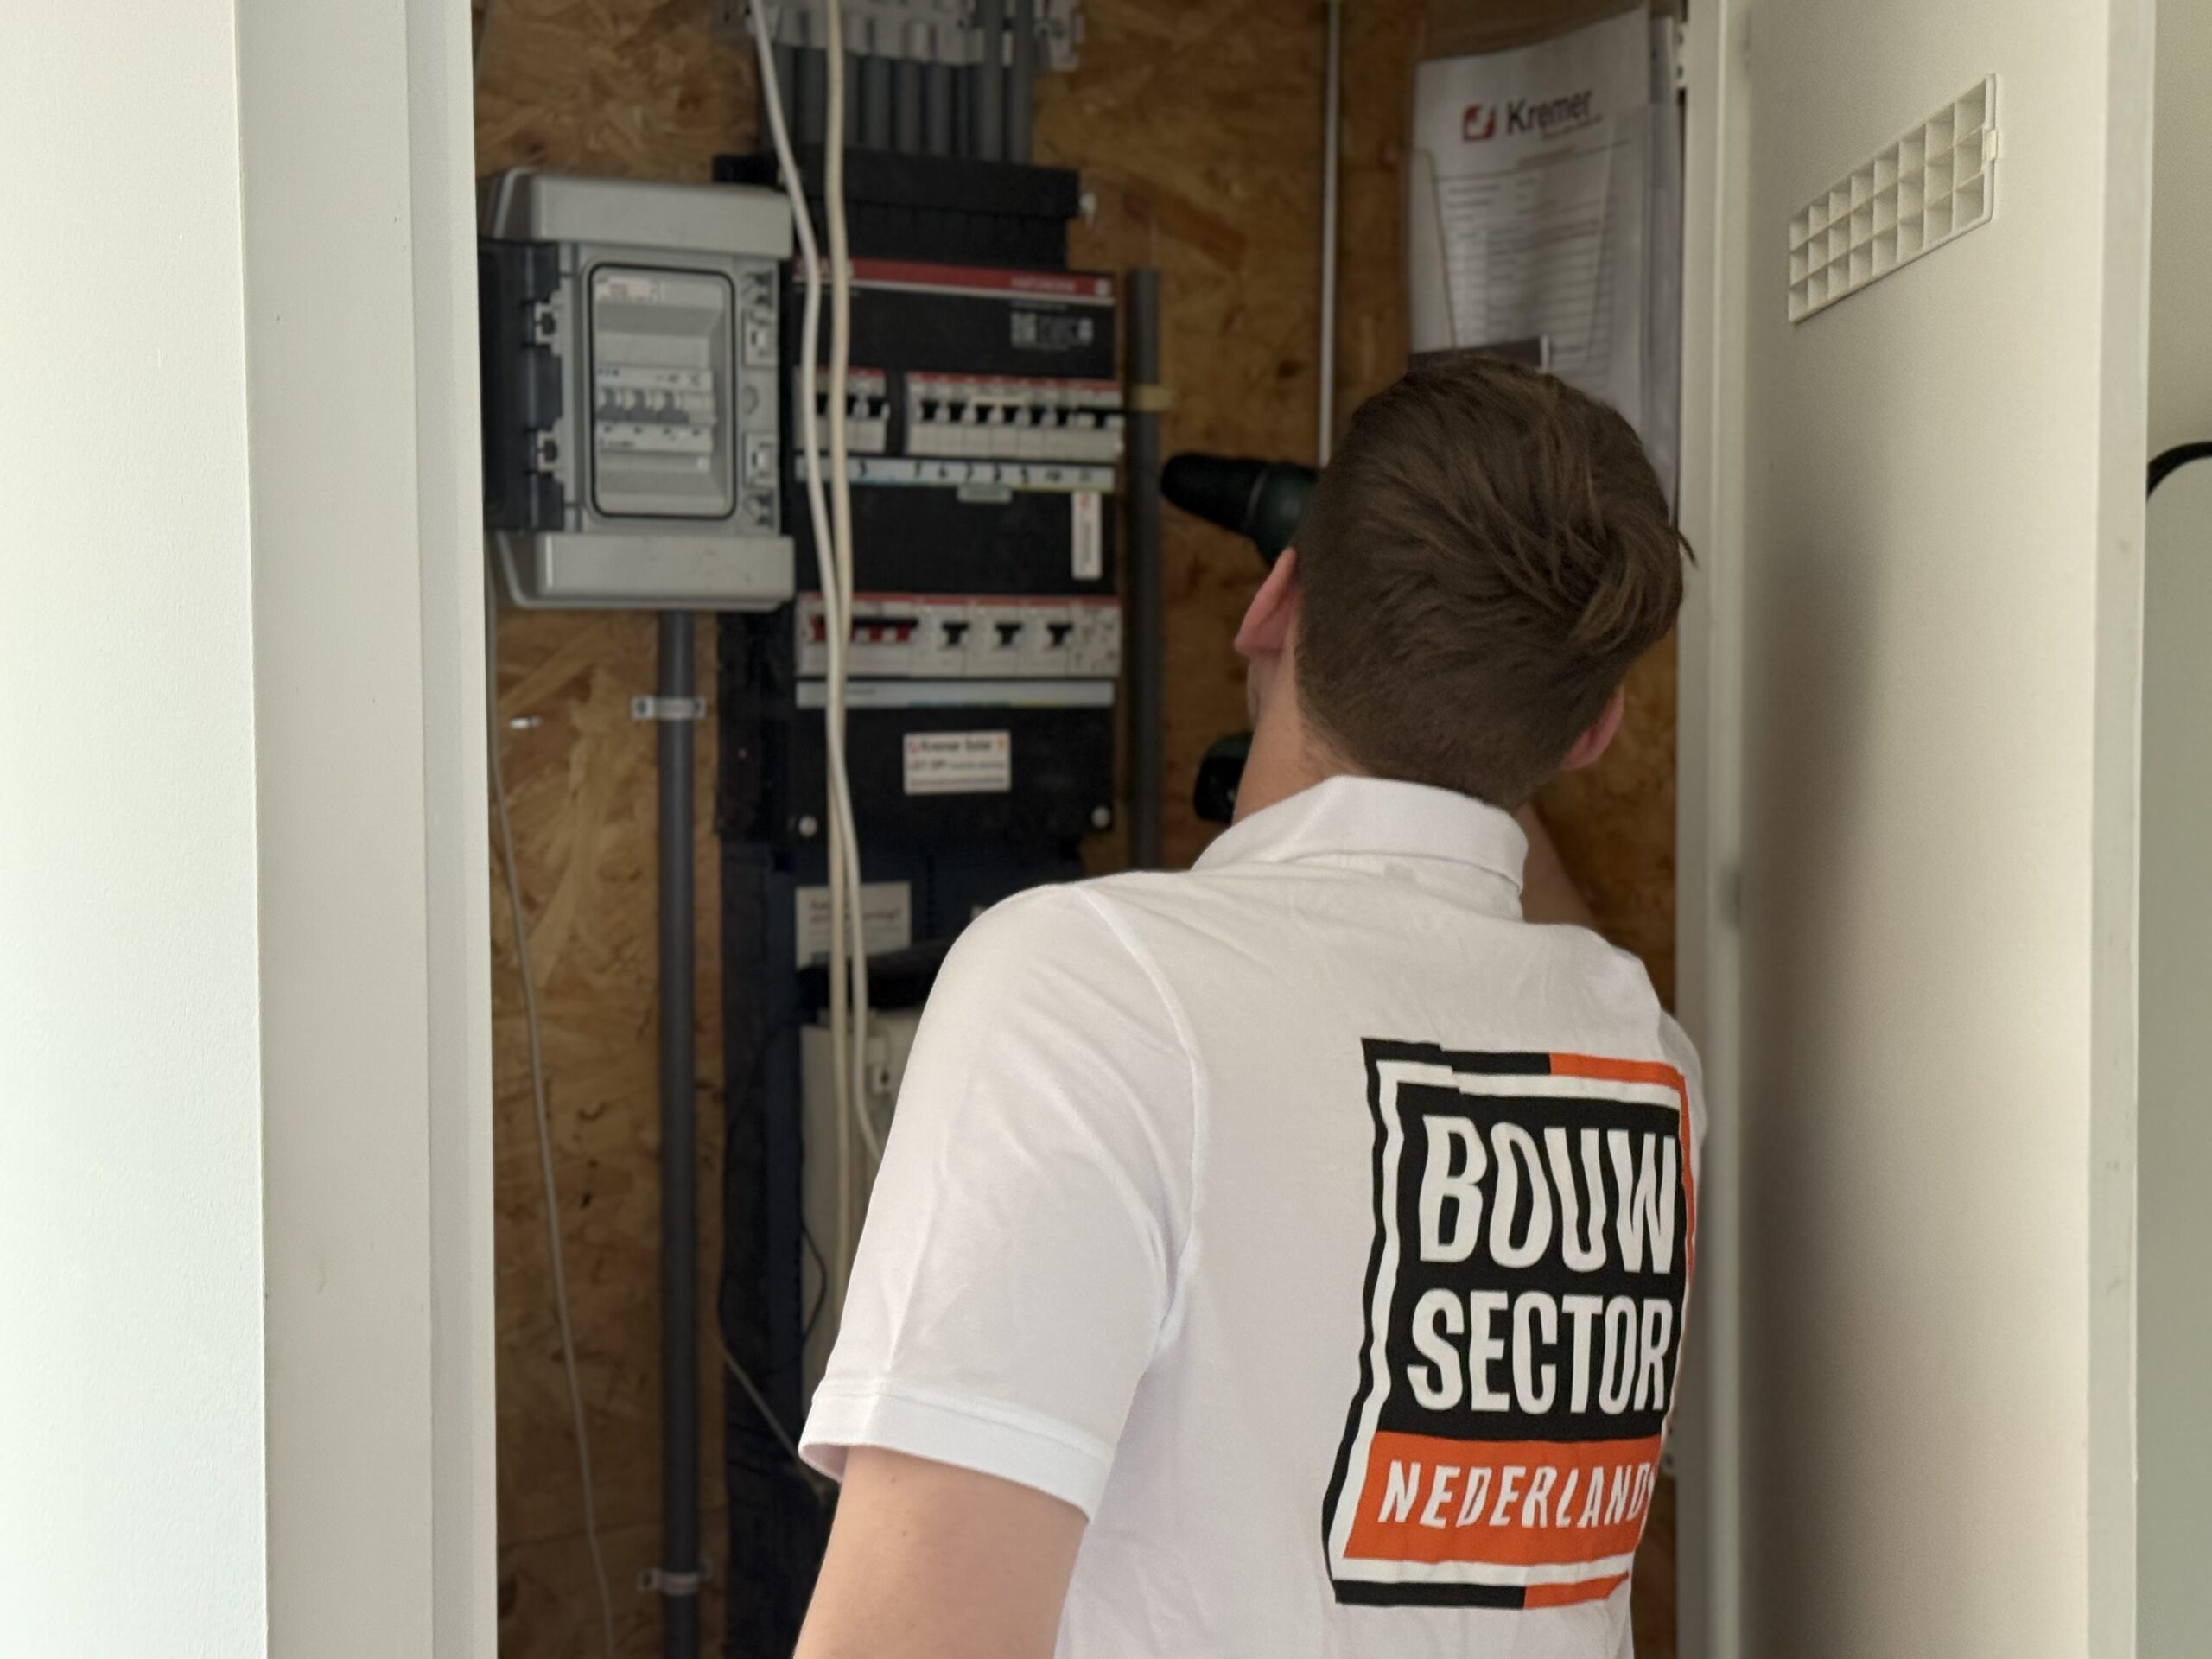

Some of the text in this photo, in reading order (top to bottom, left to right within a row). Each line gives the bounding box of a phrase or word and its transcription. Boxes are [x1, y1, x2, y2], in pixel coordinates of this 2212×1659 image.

[1506, 90, 1592, 135] Kremer
[1419, 1115, 1676, 1274] BOUW
[1407, 1288, 1672, 1415] SECTOR
